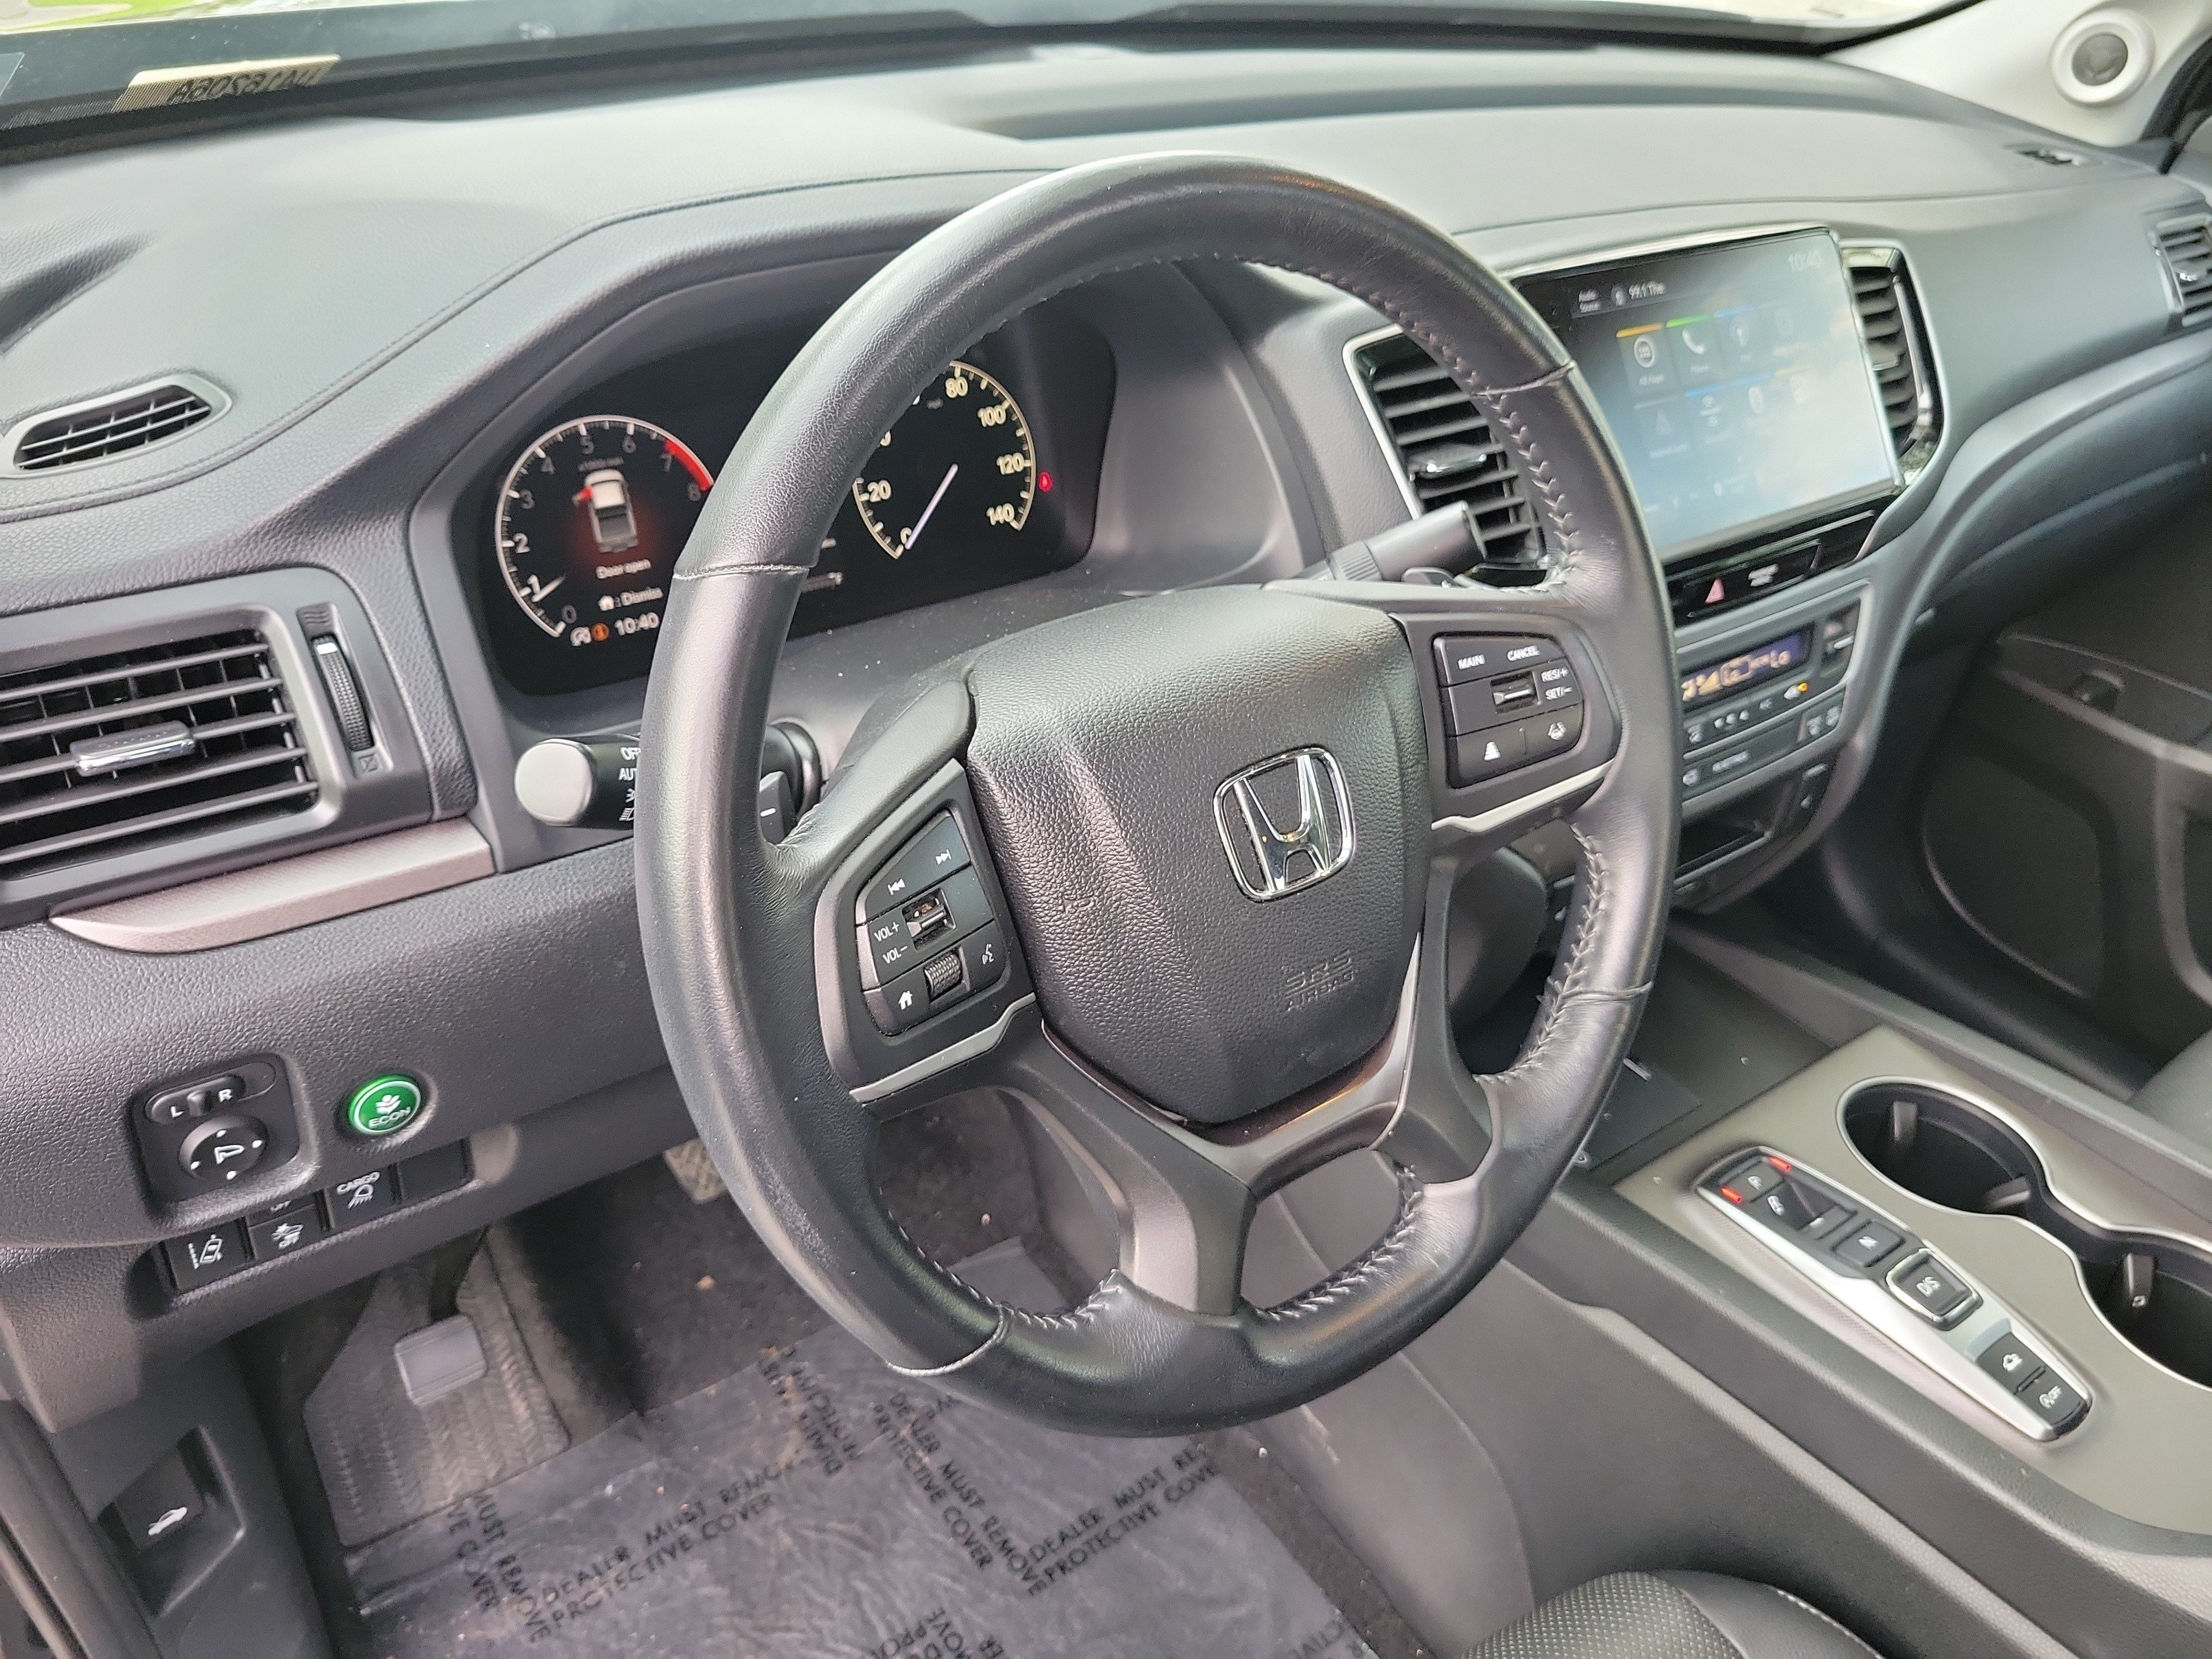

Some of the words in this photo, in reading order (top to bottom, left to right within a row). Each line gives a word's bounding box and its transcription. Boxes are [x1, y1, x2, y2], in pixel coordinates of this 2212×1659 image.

[945, 377, 968, 398] 80
[978, 405, 1006, 426] 100
[581, 435, 594, 454] 5
[622, 435, 636, 454] 6
[661, 453, 672, 472] 7
[996, 452, 1025, 475] 120
[521, 490, 534, 509] 3
[689, 483, 701, 501] 8
[868, 480, 891, 502] 20
[986, 503, 1015, 525] 140
[513, 533, 530, 554] 2
[527, 574, 540, 595] 1
[561, 604, 577, 624] 0
[614, 612, 660, 636] 10:40
[1458, 654, 1485, 670] MAIN
[1507, 645, 1540, 661] CANCEL
[1541, 668, 1569, 682] RES/+
[218, 1088, 233, 1103] R
[171, 1105, 185, 1118] L
[369, 1106, 411, 1129] ECON
[336, 1171, 380, 1195] CARGO
[1858, 1235, 1878, 1250] N
[1113, 1466, 1166, 1509] MUST
[701, 1491, 775, 1540] COVER
[938, 1459, 986, 1509] MUST
[981, 1515, 1047, 1595] REMOVE
[943, 1505, 994, 1570] COVER
[499, 1554, 551, 1643] REMOVE
